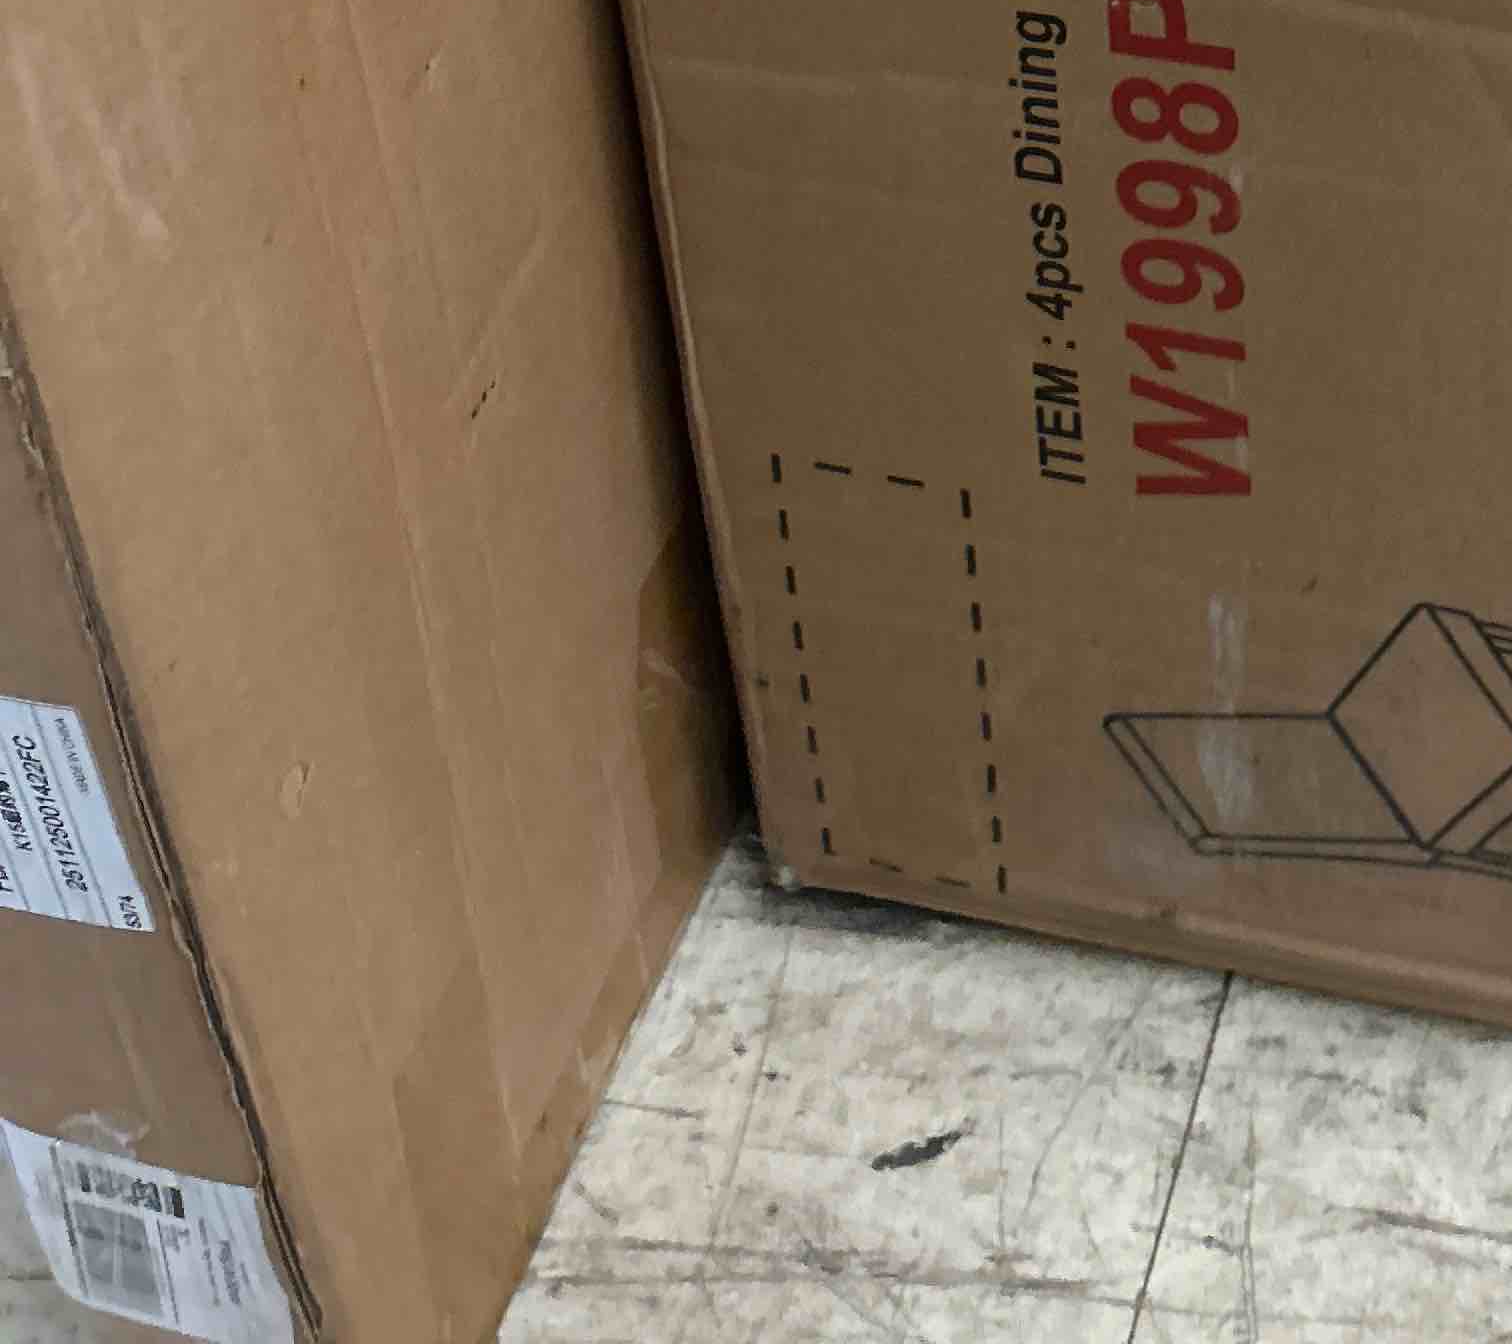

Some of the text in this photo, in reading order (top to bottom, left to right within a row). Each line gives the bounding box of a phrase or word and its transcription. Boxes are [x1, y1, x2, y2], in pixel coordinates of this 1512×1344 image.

[1008, 11, 1067, 185] Dining
[1026, 202, 1084, 320] 4pcs
[1032, 362, 1087, 485] ITEM
